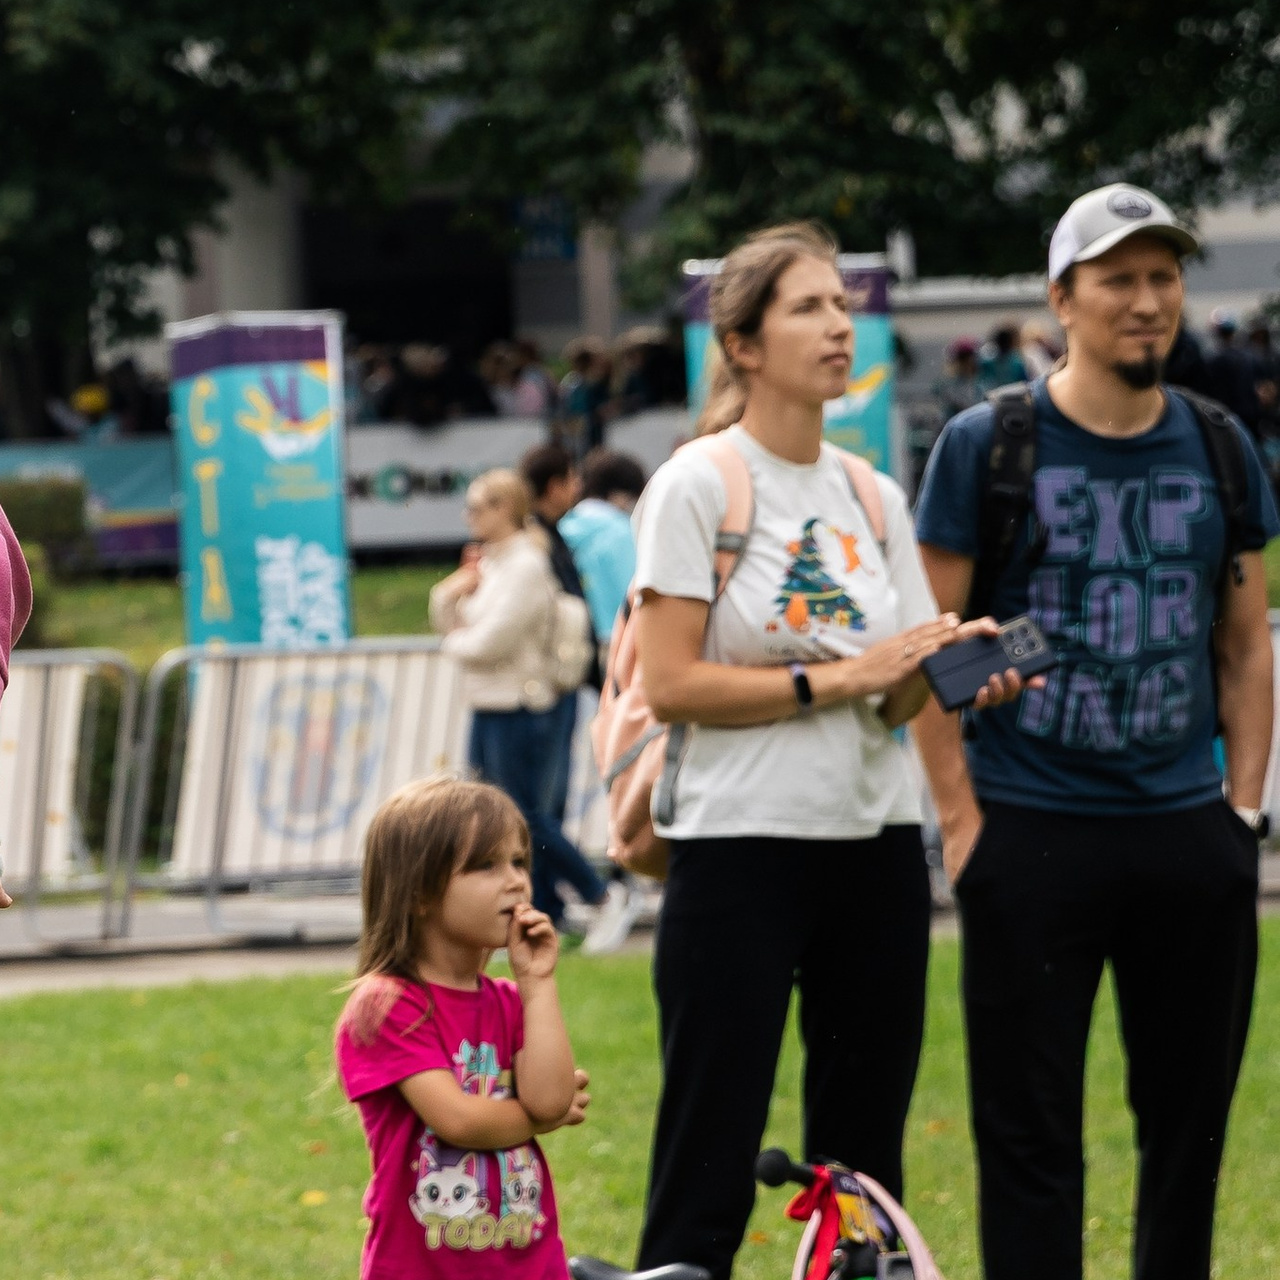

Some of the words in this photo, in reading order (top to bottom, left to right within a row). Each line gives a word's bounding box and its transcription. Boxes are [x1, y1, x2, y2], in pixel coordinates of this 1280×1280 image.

[1031, 467, 1213, 567] EXP
[1027, 565, 1200, 657] LOR
[1018, 660, 1192, 749] ING
[421, 1211, 533, 1251] TODAY
